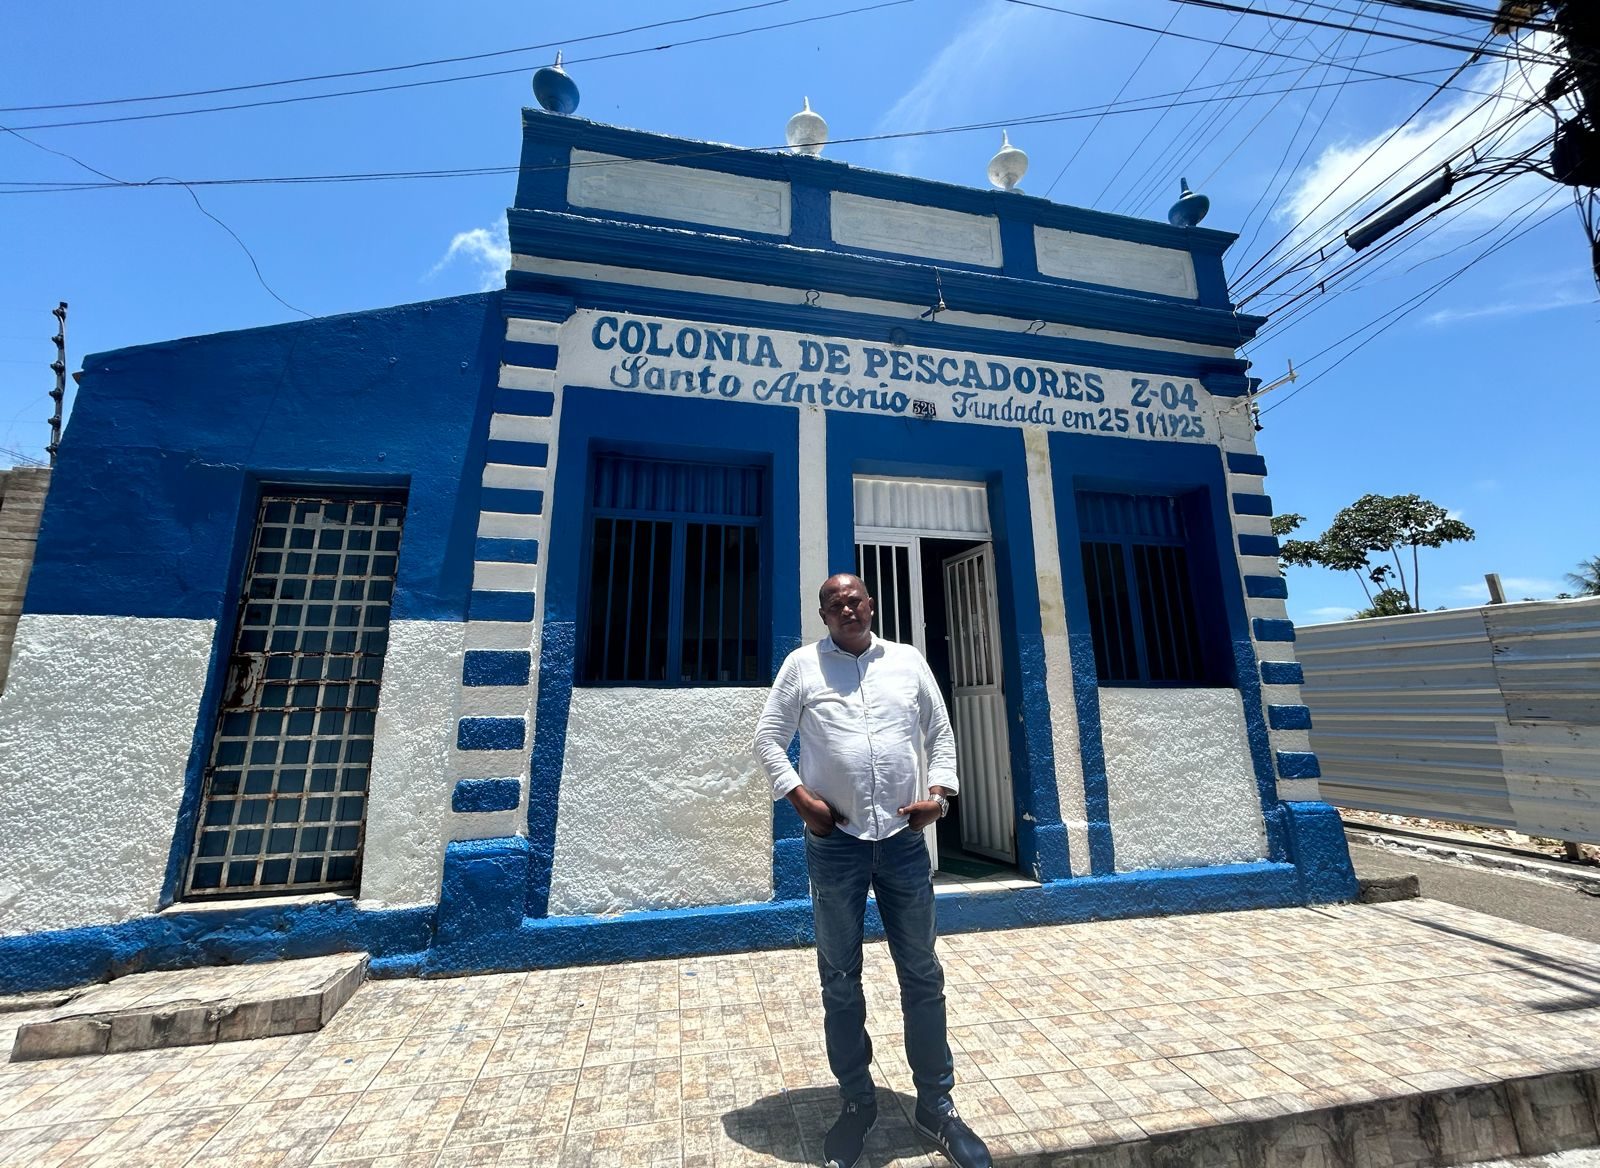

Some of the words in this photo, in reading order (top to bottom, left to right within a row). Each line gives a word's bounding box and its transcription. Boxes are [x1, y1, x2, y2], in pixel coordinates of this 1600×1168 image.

[591, 316, 782, 369] COLONIA
[798, 340, 851, 376] DE
[862, 347, 1106, 405] PESCADORES
[1131, 378, 1199, 412] Z-04
[609, 356, 742, 398] Santo
[913, 400, 936, 417] 326
[952, 391, 1056, 426] Fundada
[1062, 410, 1096, 430] em
[1098, 407, 1130, 432] 25
